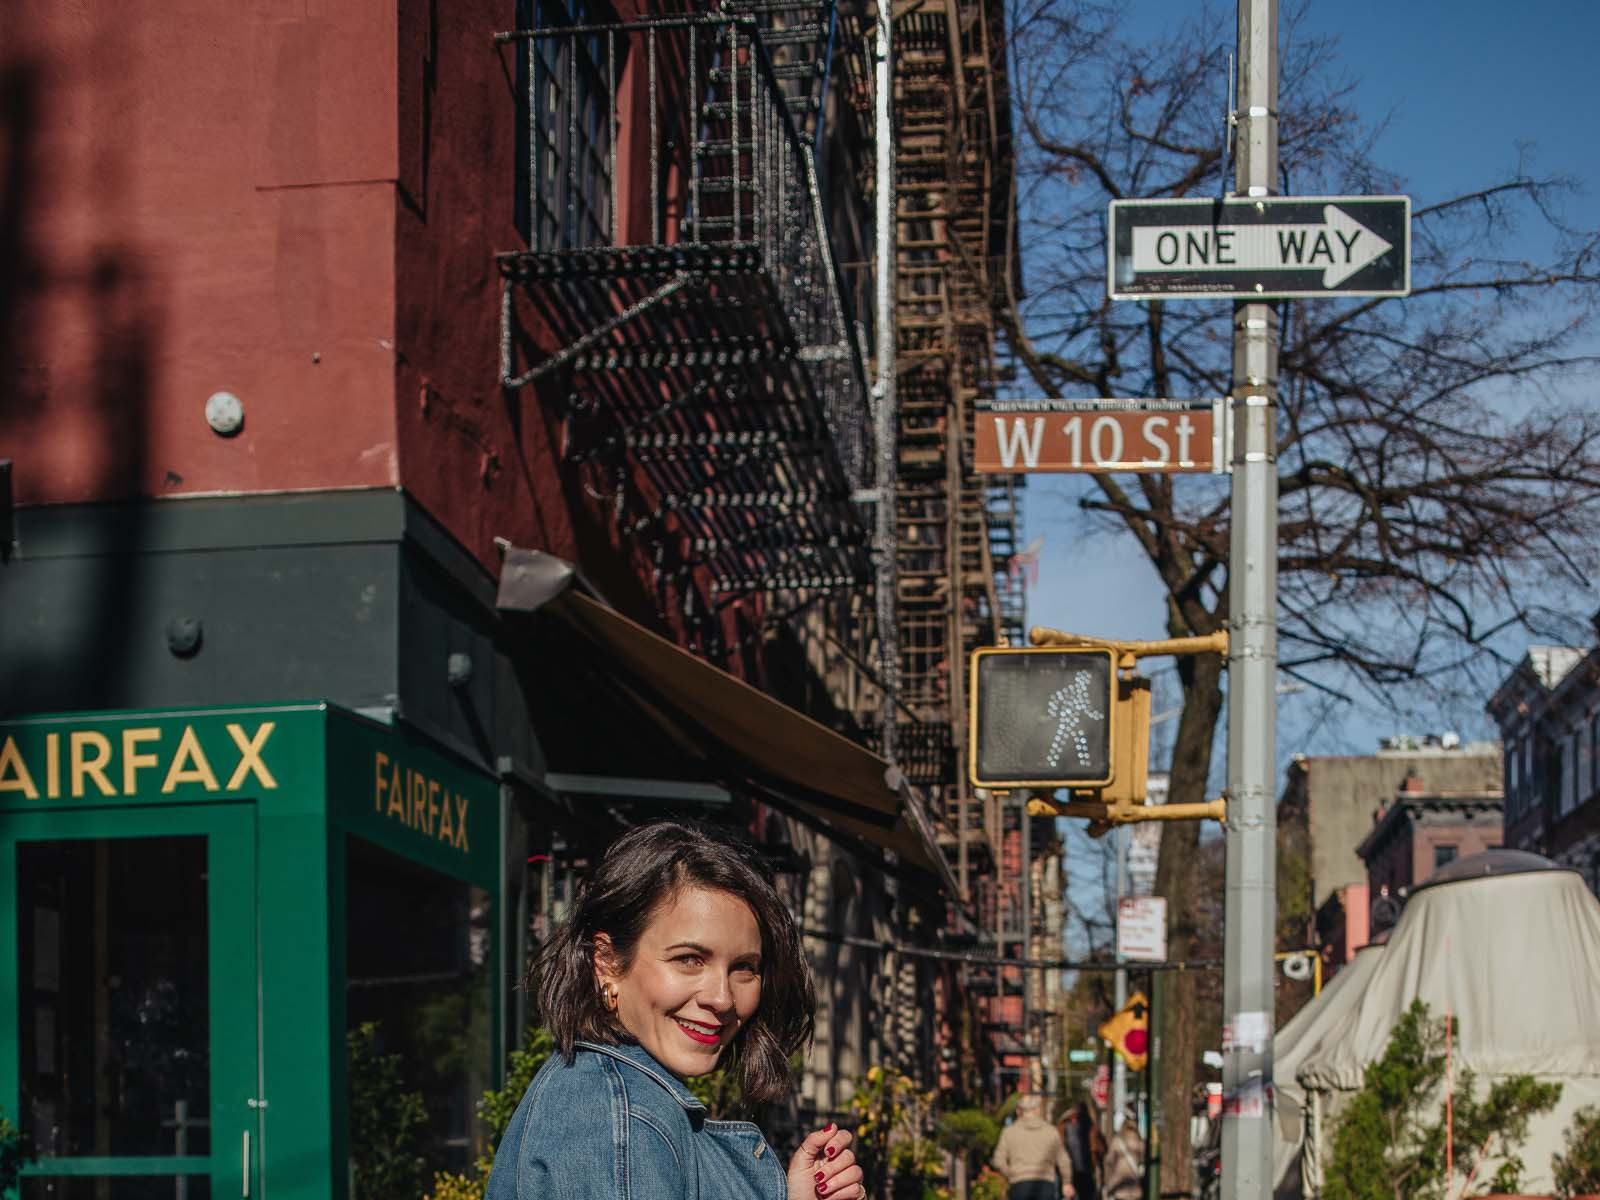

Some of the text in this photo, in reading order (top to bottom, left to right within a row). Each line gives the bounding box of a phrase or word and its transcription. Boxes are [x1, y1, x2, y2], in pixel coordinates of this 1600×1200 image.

[1156, 229, 1362, 265] ONE WAY
[994, 414, 1196, 469] W 10 St
[0, 721, 278, 800] AIRFAX
[373, 751, 470, 853] FAIRFAX
